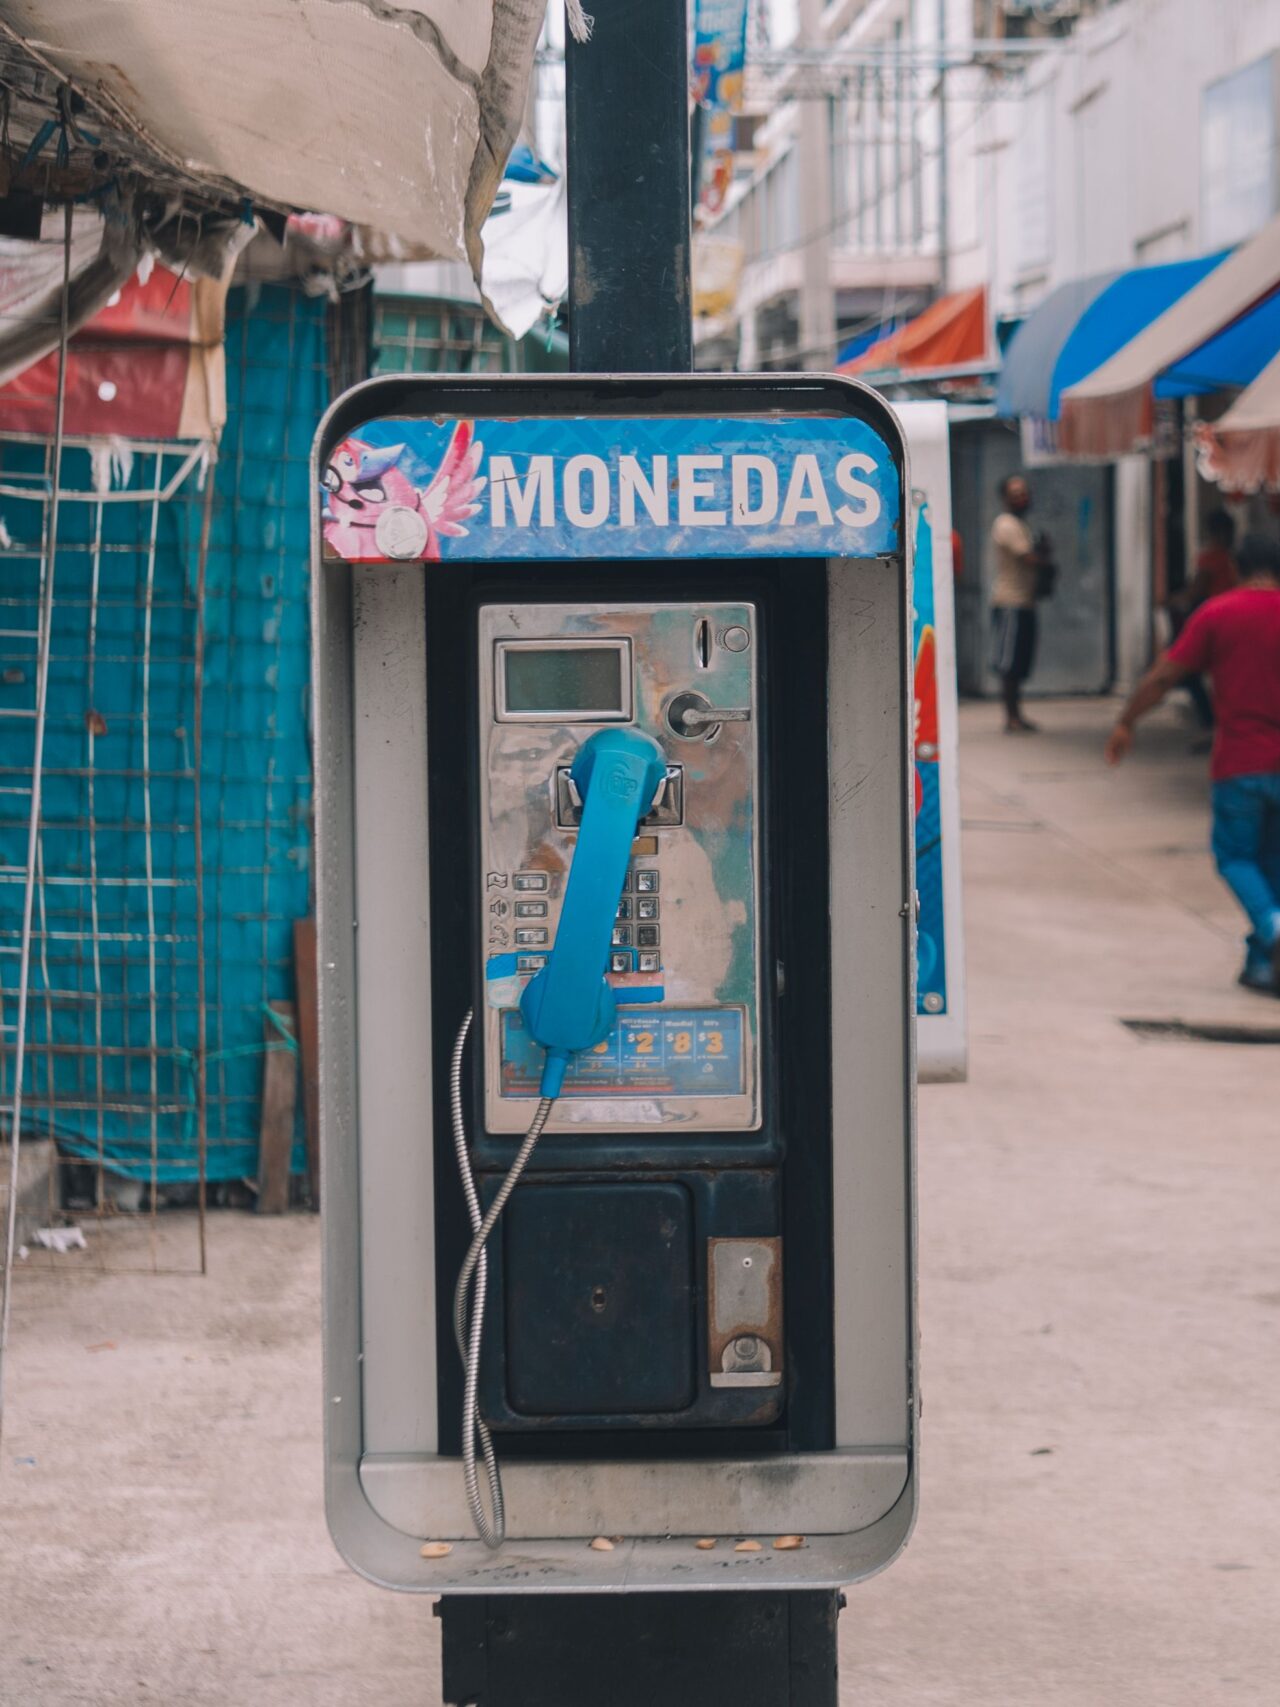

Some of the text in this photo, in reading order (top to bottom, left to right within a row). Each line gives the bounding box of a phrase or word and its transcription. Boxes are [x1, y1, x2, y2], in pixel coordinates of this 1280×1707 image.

[489, 453, 882, 529] MONEDAS
[666, 1031, 691, 1055] $8
[698, 1031, 724, 1055] $3
